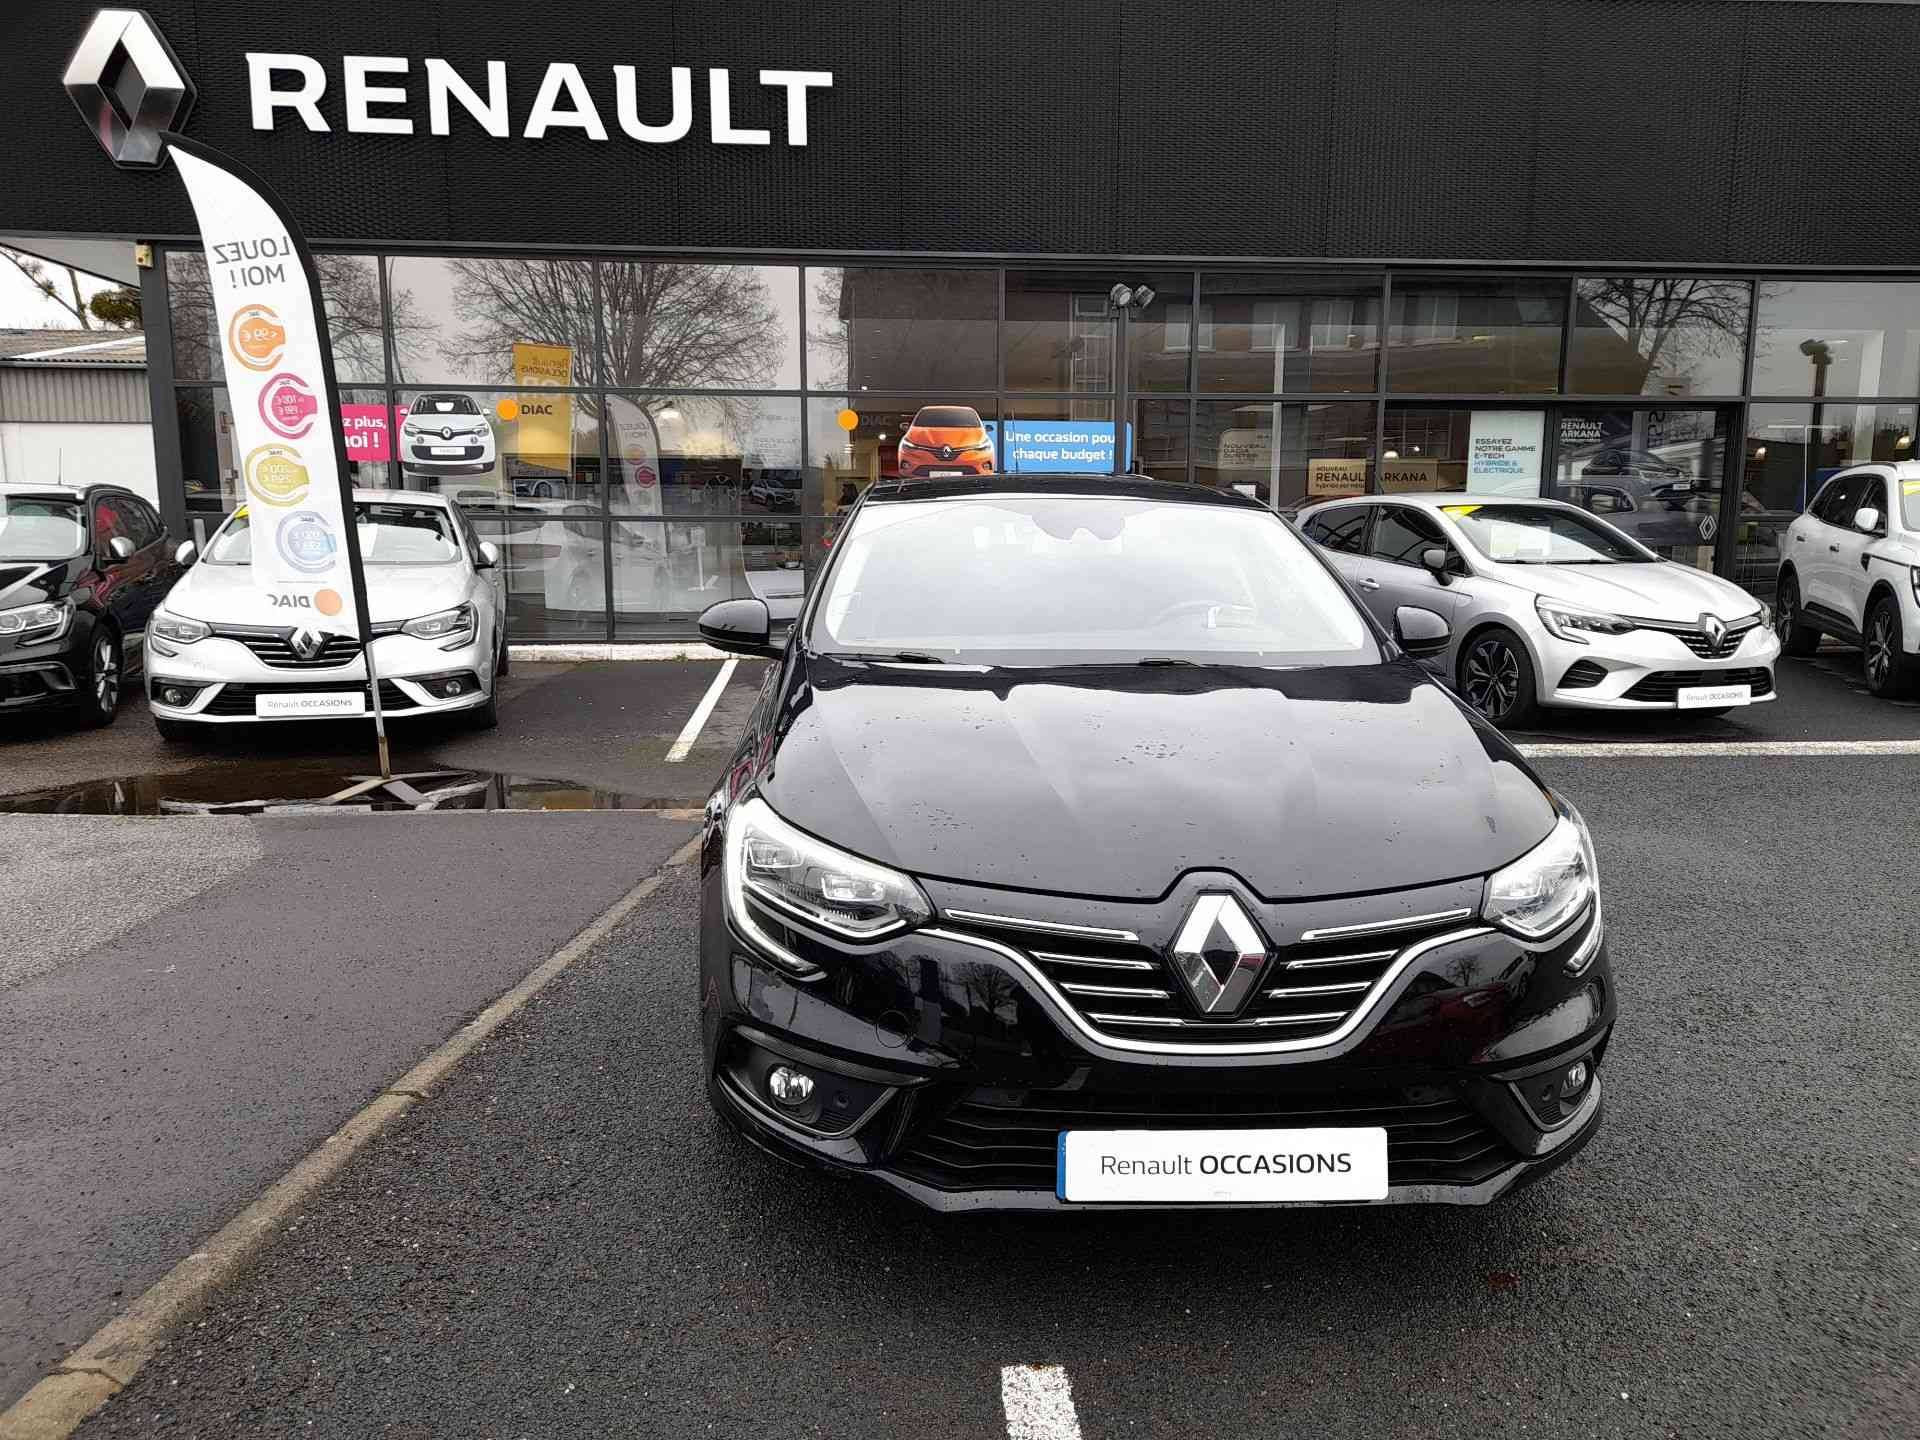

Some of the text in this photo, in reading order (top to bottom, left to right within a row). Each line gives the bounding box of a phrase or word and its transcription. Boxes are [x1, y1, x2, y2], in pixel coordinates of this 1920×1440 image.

[246, 53, 833, 146] RENAULT
[521, 404, 553, 415] DIAC
[354, 415, 387, 430] plus,
[1561, 422, 1604, 430] RENAULT
[1005, 430, 1115, 445] Une occasion pou
[1561, 430, 1601, 438] ARKANA
[1012, 447, 1058, 461] chaque
[1061, 448, 1106, 462] budget
[1316, 472, 1365, 482] RENAUL
[267, 699, 353, 709] Renault OCCASIONS
[1101, 1152, 1352, 1176] Renault OCCASIONS
